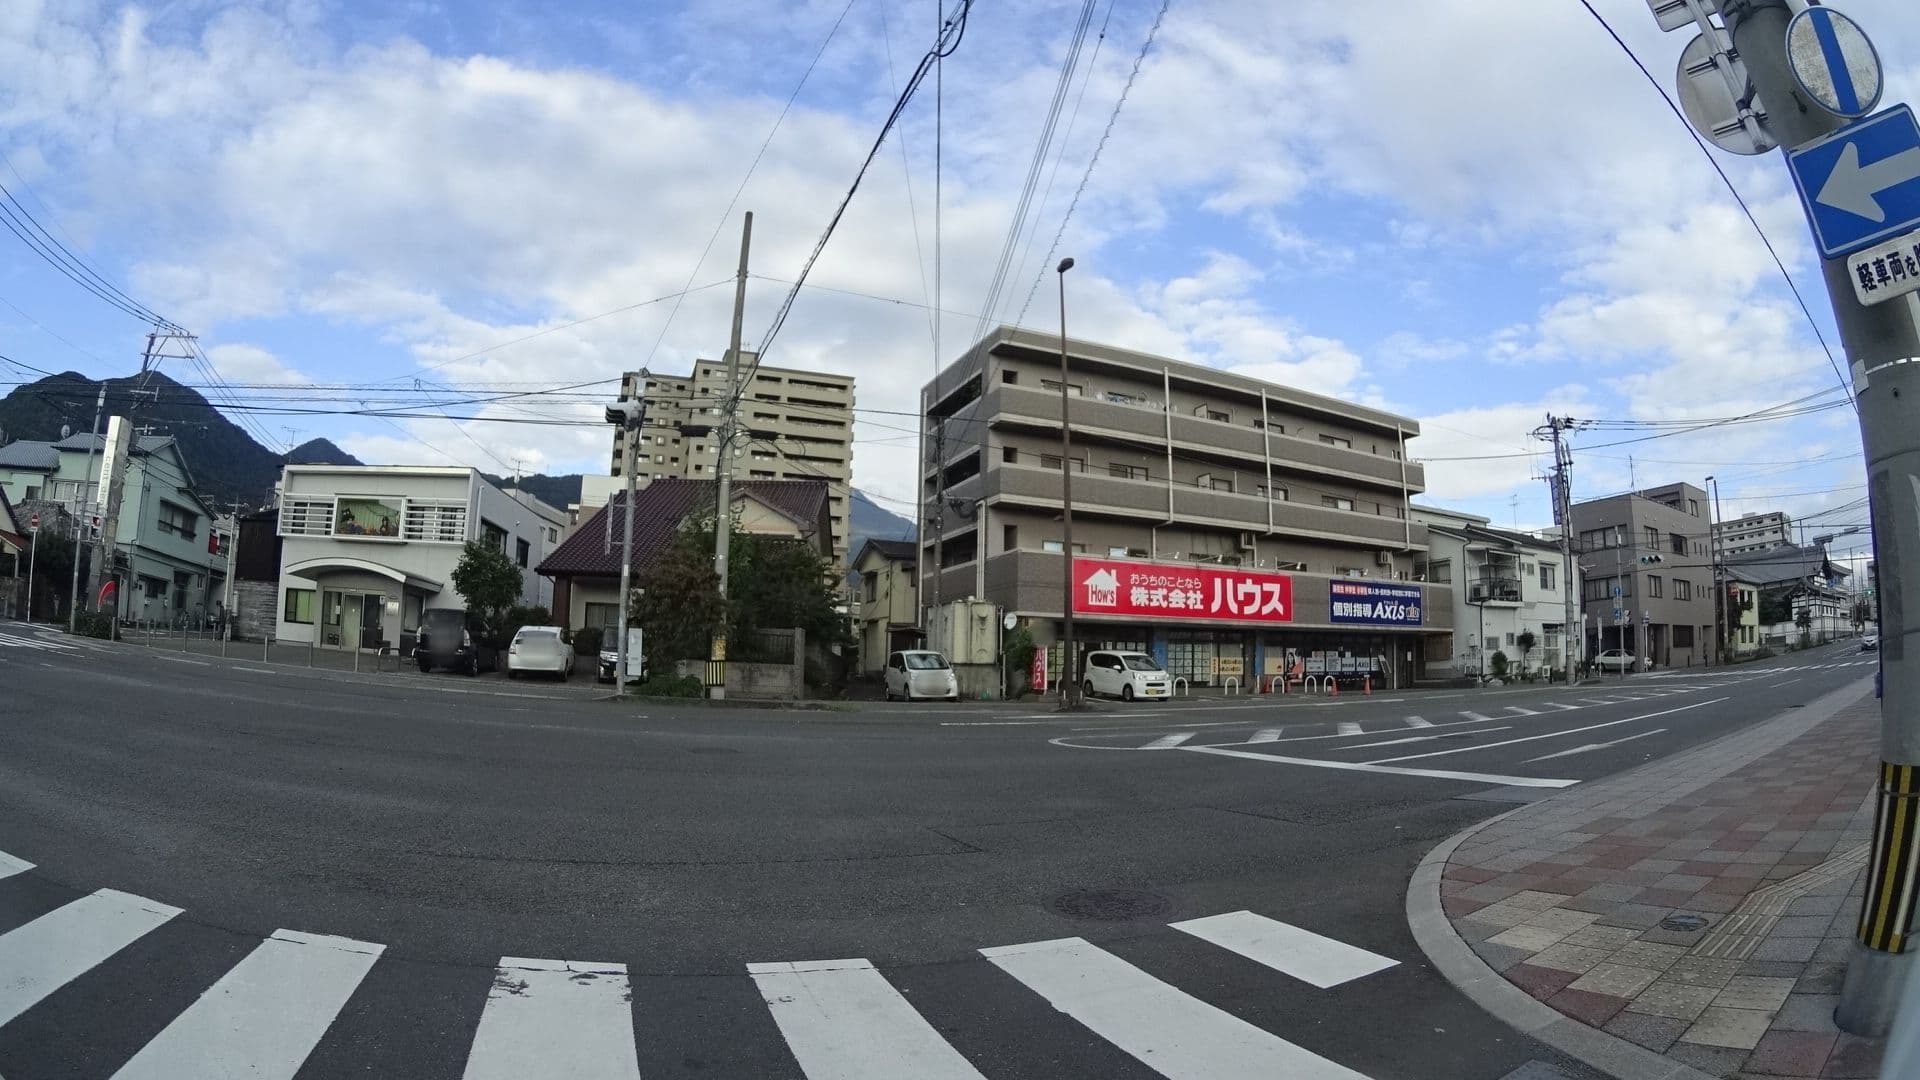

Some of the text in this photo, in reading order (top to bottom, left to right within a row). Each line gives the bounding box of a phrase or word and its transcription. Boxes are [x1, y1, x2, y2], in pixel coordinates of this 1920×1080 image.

[1130, 573, 1202, 589] おうちのことなら
[1130, 577, 1284, 616] 株式会社 ハウス
[1333, 601, 1372, 618] 個別指導
[1372, 600, 1405, 620] Axis
